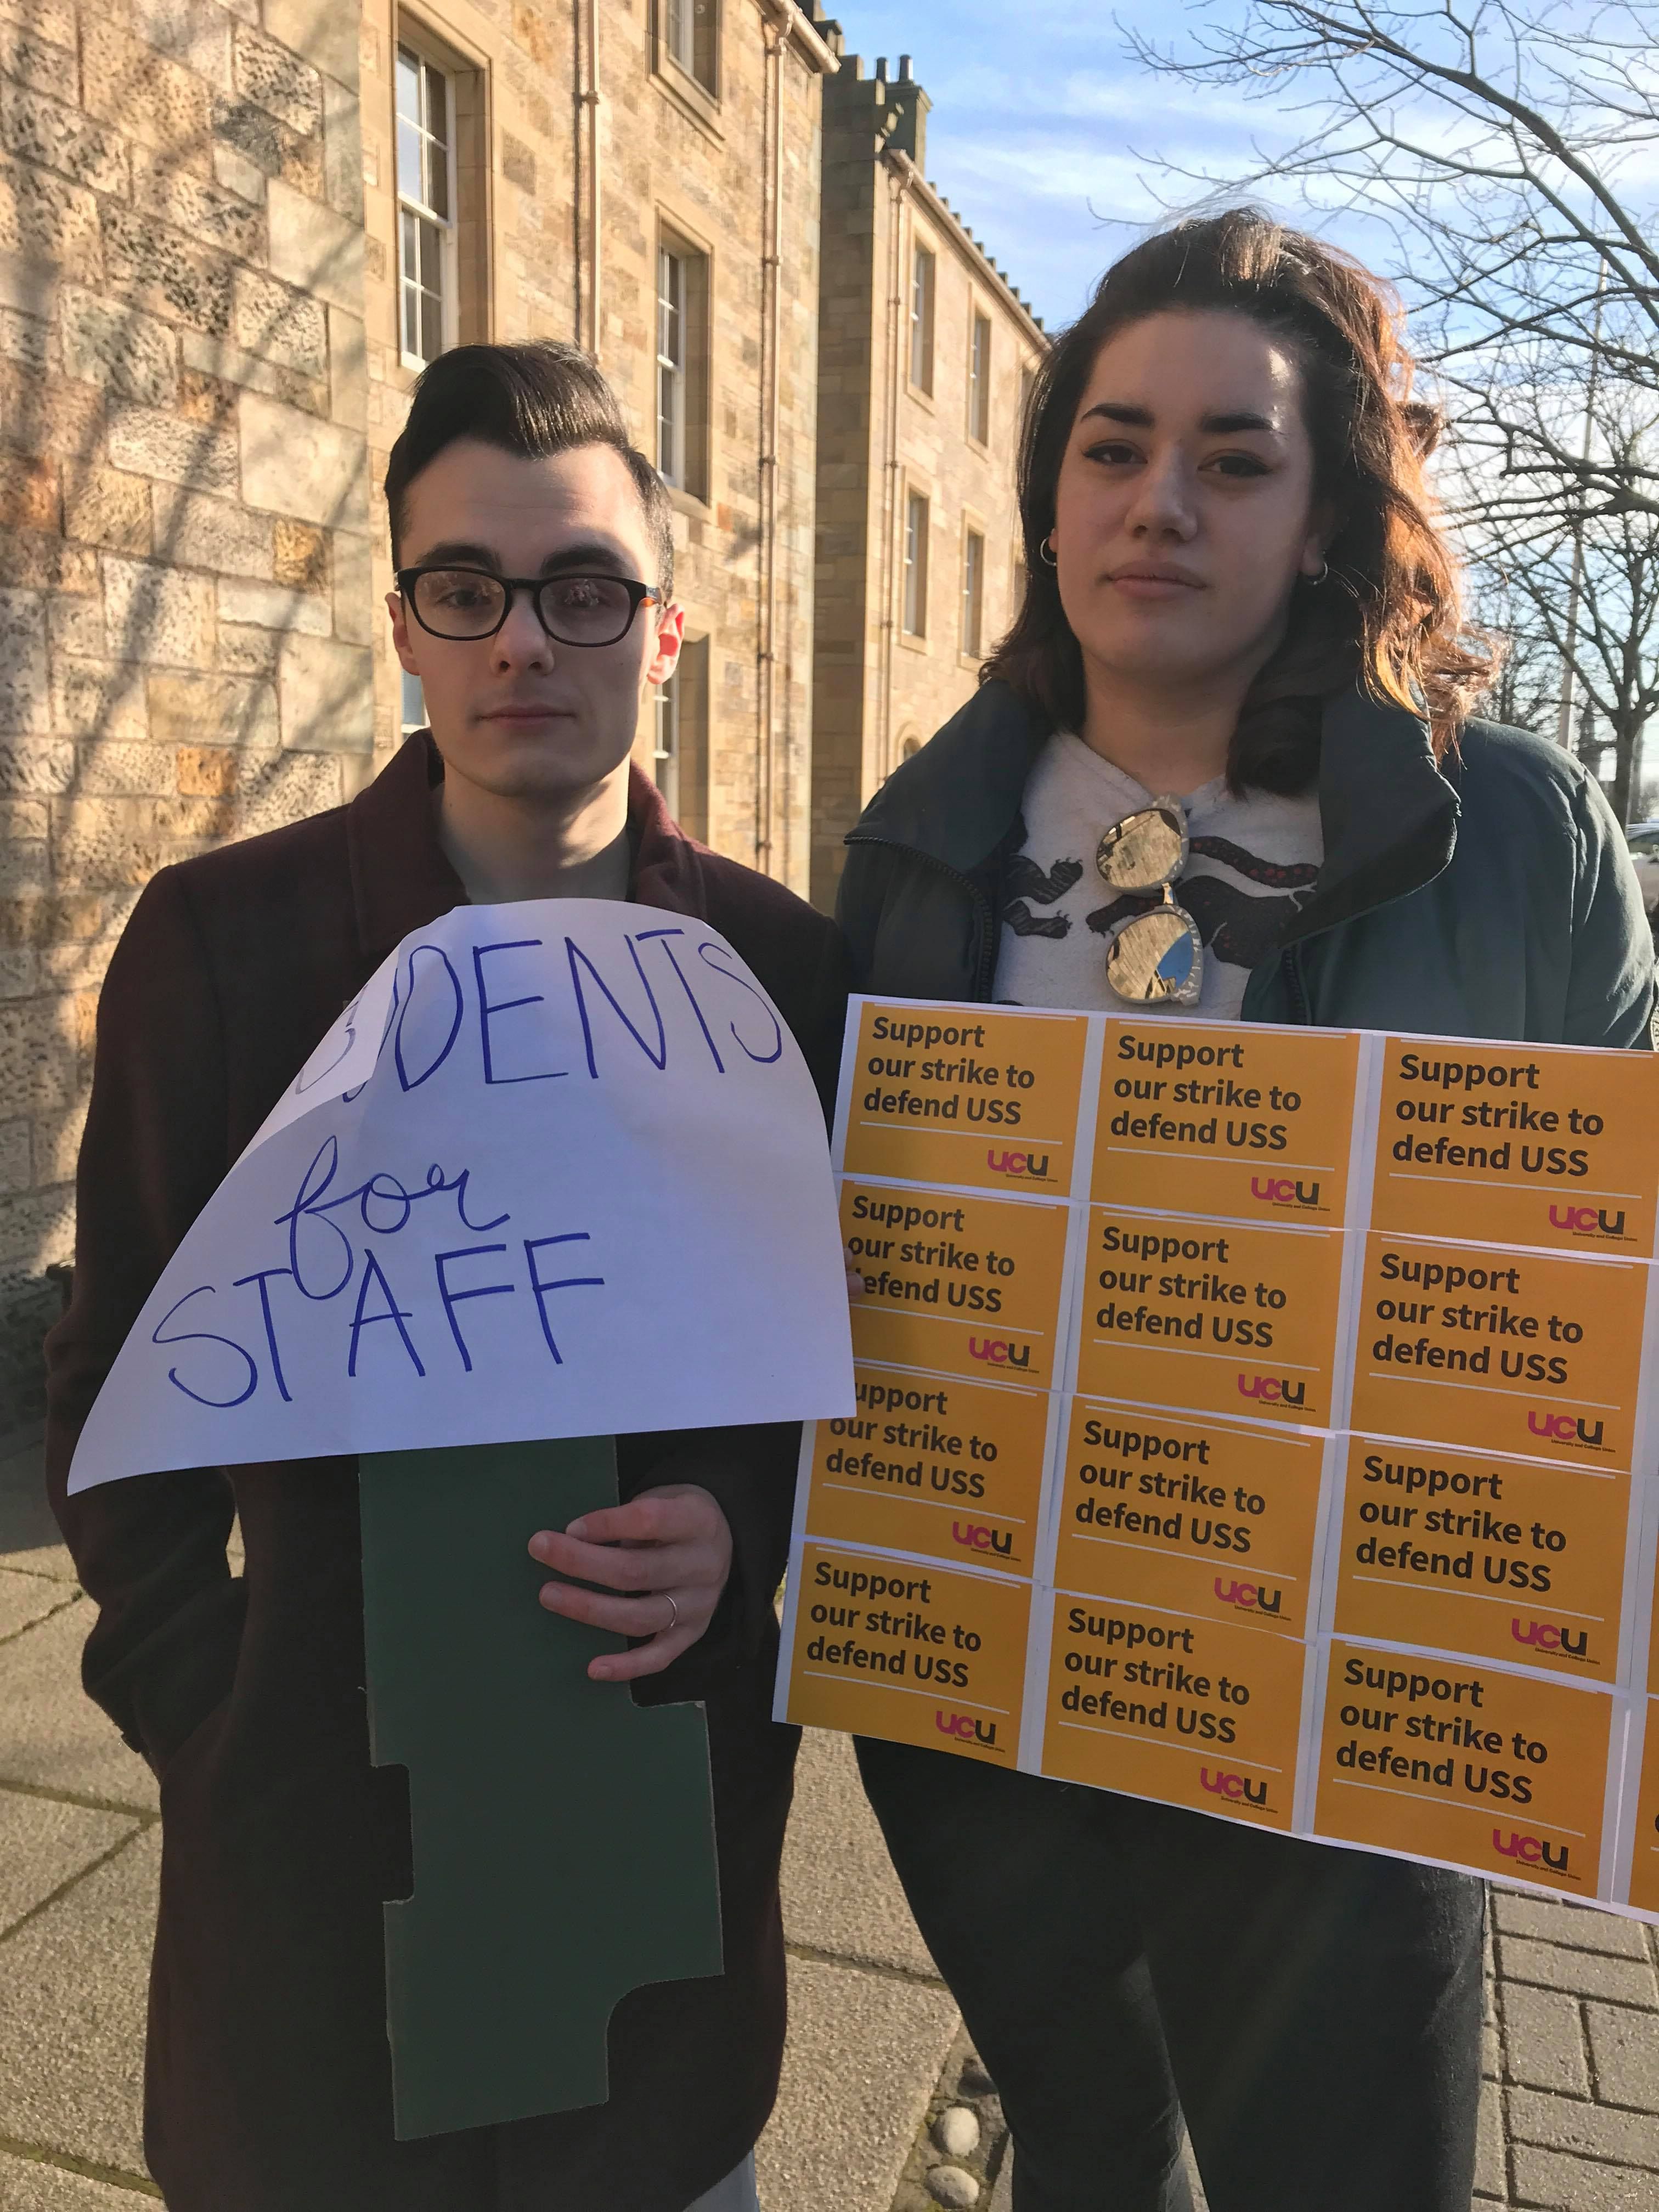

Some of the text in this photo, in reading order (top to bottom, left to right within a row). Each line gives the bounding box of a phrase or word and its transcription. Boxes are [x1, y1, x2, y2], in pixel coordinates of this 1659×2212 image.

[872, 1016, 985, 1049] Support
[1118, 1035, 1244, 1069] Support
[868, 1057, 1034, 1088] our strike to
[1399, 1054, 1539, 1091] Support
[864, 1087, 1021, 1124] defend USS
[1114, 1079, 1301, 1111] our strike to
[1110, 1110, 1286, 1150] defend USS
[1396, 1100, 1603, 1135] our strike to
[1392, 1134, 1588, 1176] defend USS
[275, 1135, 510, 1300] for
[851, 1195, 964, 1232] Support
[848, 1237, 1014, 1276] our strike to
[1102, 1226, 1228, 1263] Support
[856, 1267, 1001, 1312] efend USS
[1099, 1270, 1286, 1308] our strike to
[1380, 1253, 1520, 1294] Support
[152, 1232, 605, 1407] STAFF
[1097, 1302, 1272, 1347] defend USS
[1376, 1300, 1583, 1343] our strike to
[1373, 1334, 1567, 1384] defend USS
[854, 1382, 948, 1415] upport
[830, 1418, 997, 1462] our strike to
[1083, 1420, 1210, 1464] Support
[826, 1448, 984, 1498] defend USS
[1080, 1464, 1265, 1514] our strike to
[1363, 1455, 1502, 1499] Support
[1076, 1497, 1251, 1553] defend USS
[1359, 1502, 1566, 1551] our strike to
[814, 1561, 931, 1603] Support
[1356, 1537, 1550, 1592] defend USS
[810, 1604, 981, 1651] our strike to
[1068, 1608, 1194, 1653] Support
[806, 1635, 968, 1687] defend USS
[1064, 1652, 1249, 1705] our strike to
[1344, 1658, 1483, 1707] Support
[1062, 1685, 1235, 1743] defend USS
[1340, 1705, 1547, 1763] our strike to
[1336, 1740, 1532, 1803] defend USS
